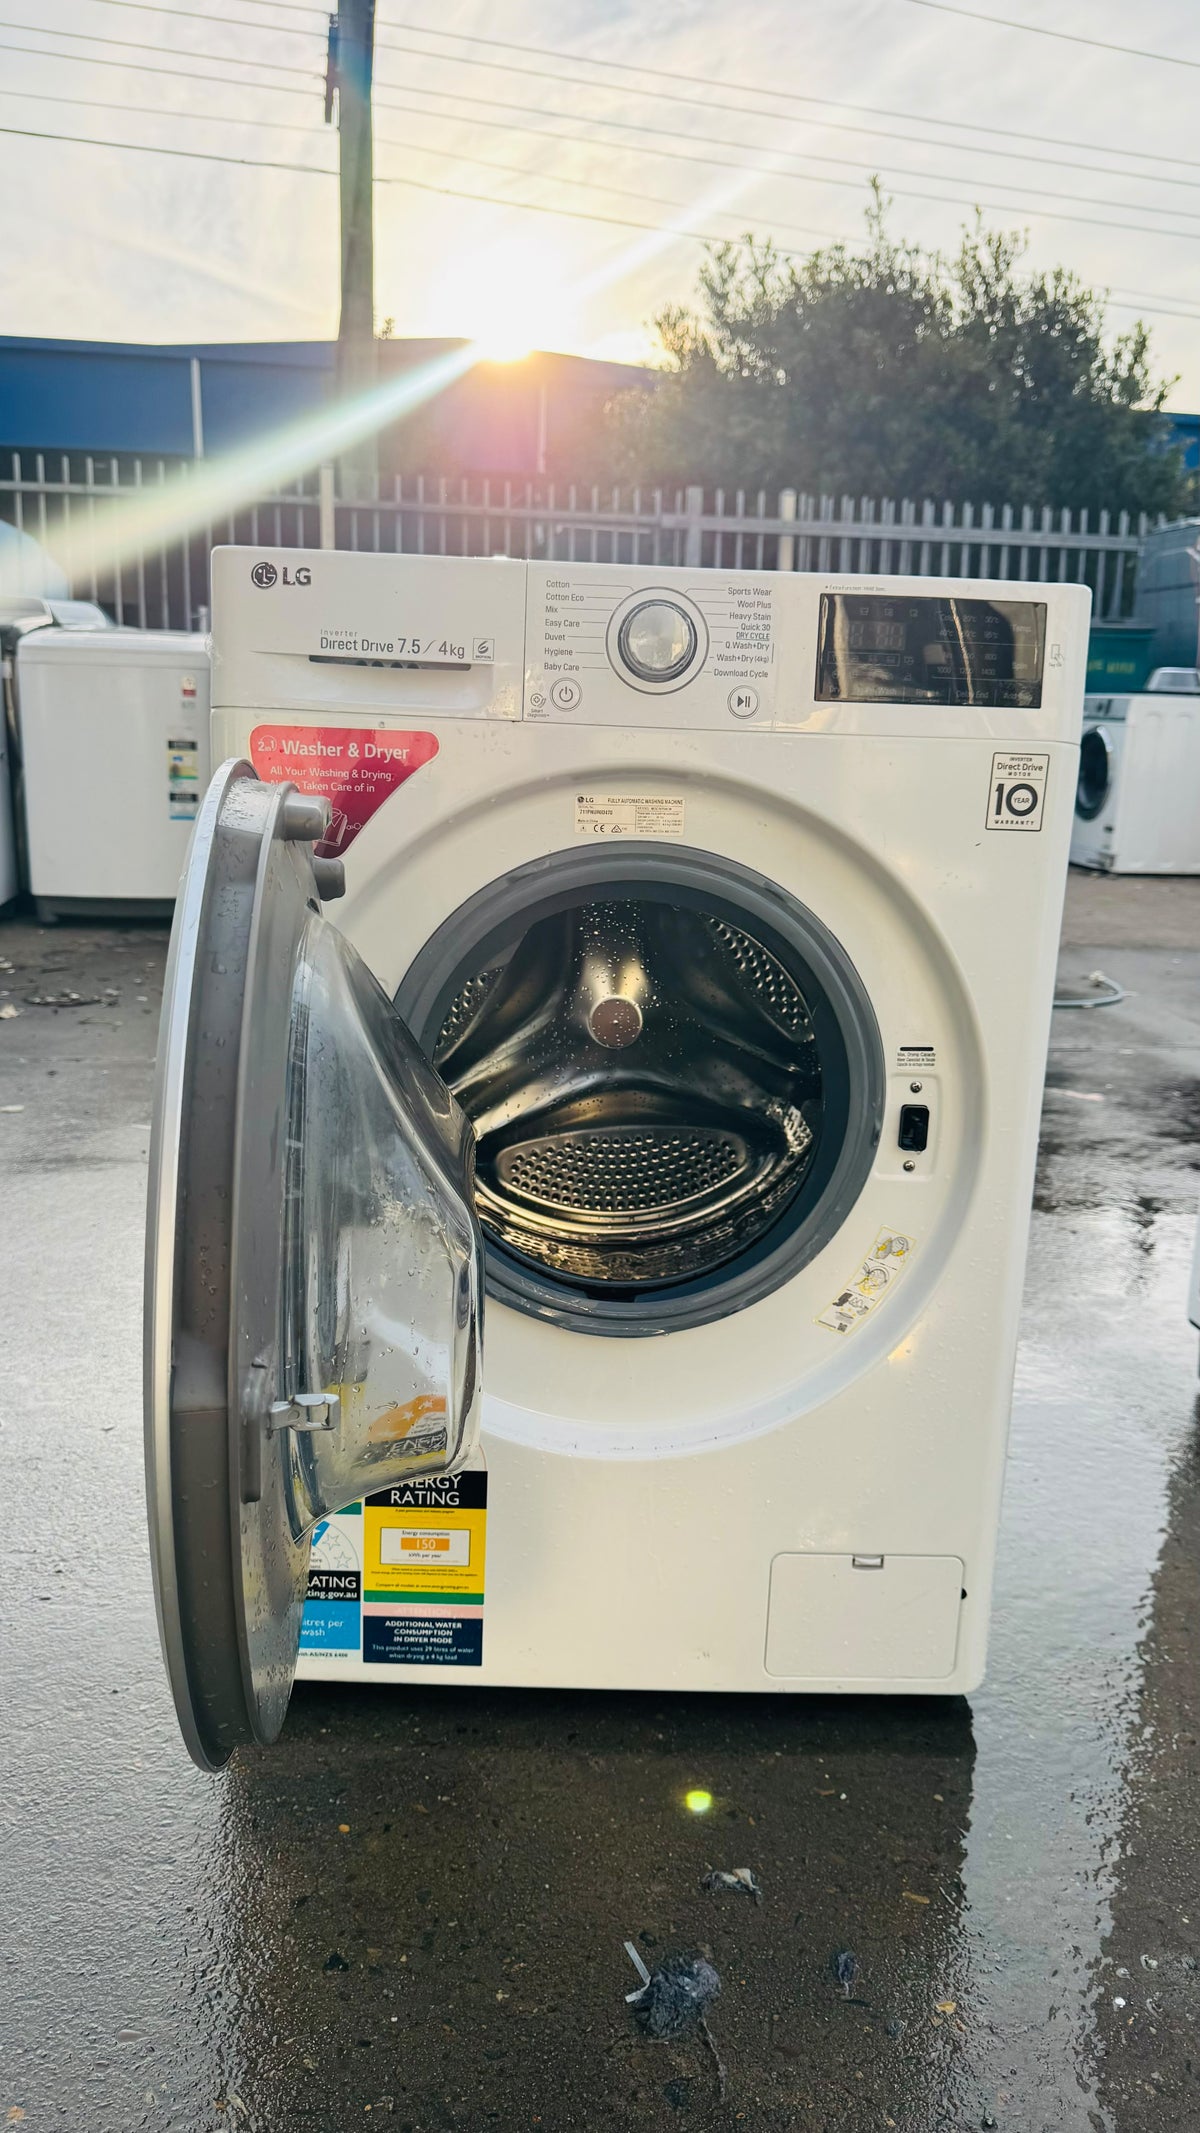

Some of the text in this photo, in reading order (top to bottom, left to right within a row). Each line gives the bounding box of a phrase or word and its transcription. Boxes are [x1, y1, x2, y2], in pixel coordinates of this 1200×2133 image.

[283, 566, 312, 586] LG
[546, 580, 570, 588] Cotton
[728, 587, 773, 596] Sports Wear
[545, 593, 585, 602] Cotton Eco
[545, 605, 558, 613] Mix
[737, 600, 772, 609] Wool Plus
[729, 612, 772, 621] Heavy Stain
[545, 619, 580, 628] Easy Care
[741, 623, 761, 631] Quick
[320, 629, 358, 637] Inverter
[544, 633, 566, 641] Duvet
[736, 632, 749, 640] DRY
[320, 637, 358, 651] Direct
[361, 639, 394, 652] Drive
[398, 638, 421, 654] 7.5
[438, 641, 465, 659] 4kg
[544, 648, 573, 657] Hygiene
[544, 663, 580, 672] Baby Care
[714, 668, 769, 679] Download Cycle
[282, 740, 343, 757] Washer
[347, 742, 360, 758] &
[364, 744, 410, 763] Dryer
[997, 762, 1043, 771] Direct Drive
[270, 766, 282, 775] All
[285, 767, 306, 776] Your
[309, 768, 350, 780] Washing
[351, 770, 359, 778] &
[303, 781, 329, 791] Taken
[331, 783, 352, 792] Care
[354, 783, 365, 792] of
[366, 783, 375, 792] in
[995, 783, 1038, 817] 10
[397, 1475, 462, 1489] NERGY
[390, 1490, 460, 1506] RATING
[416, 1538, 436, 1550] 150
[307, 1576, 357, 1589] ATING
[328, 1620, 344, 1628] per
[385, 1620, 462, 1629] ADDITIONAL WATER
[394, 1628, 453, 1636] CONSUMPTION
